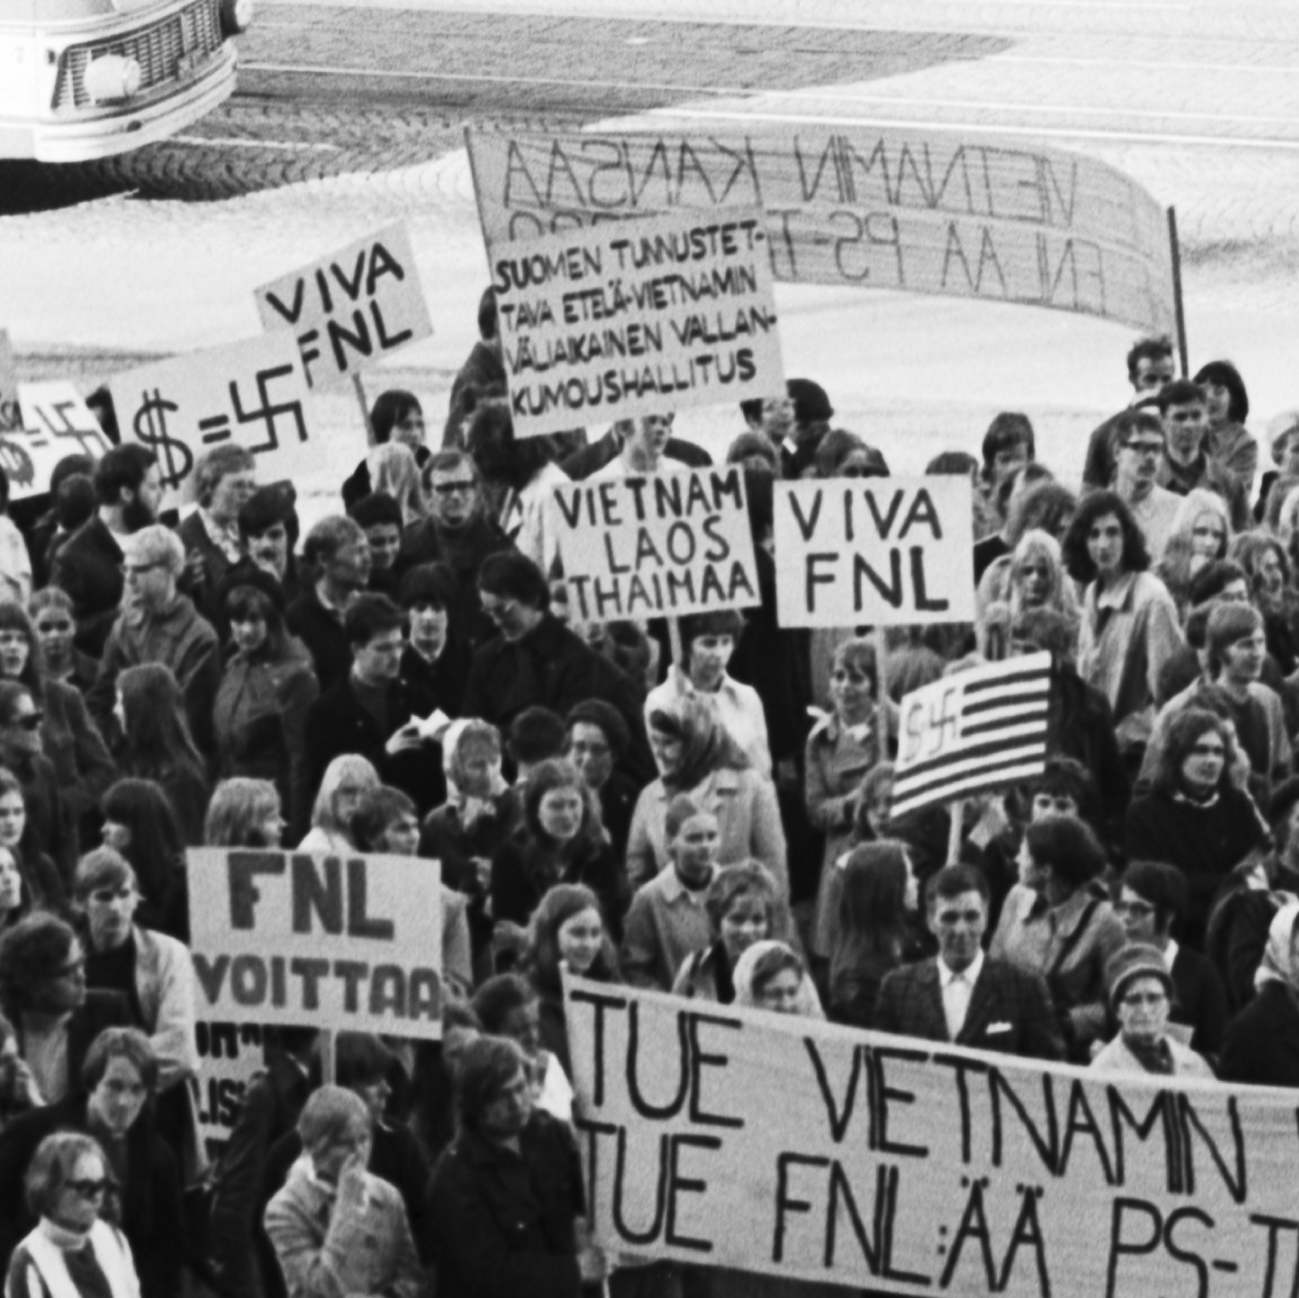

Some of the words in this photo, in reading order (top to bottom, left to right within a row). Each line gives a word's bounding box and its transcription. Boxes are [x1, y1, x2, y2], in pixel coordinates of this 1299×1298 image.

[265, 242, 404, 324] VIVA
[495, 246, 602, 294] SUOMEN
[609, 220, 765, 270] TUNNUSTET-
[501, 299, 553, 332] TAVA
[562, 265, 757, 324] ETELÄ-VIETNAMIN
[297, 299, 413, 390] FNL
[506, 323, 663, 375] VÄLIAIKAINEN
[671, 306, 777, 347] VALLAN-
[512, 349, 756, 417] KUMOUSHALLITUS
[554, 469, 745, 528] VIETNAM
[788, 487, 943, 541] VIVA
[604, 515, 731, 574] LAOS
[568, 560, 755, 620] THAIMAA
[805, 546, 949, 613] FNL
[227, 852, 395, 941] FNL
[191, 953, 441, 1021] VOITTAA
[569, 989, 744, 1128] TUE
[805, 1036, 1246, 1205] VIETNAMIN
[575, 1118, 721, 1252] TUE
